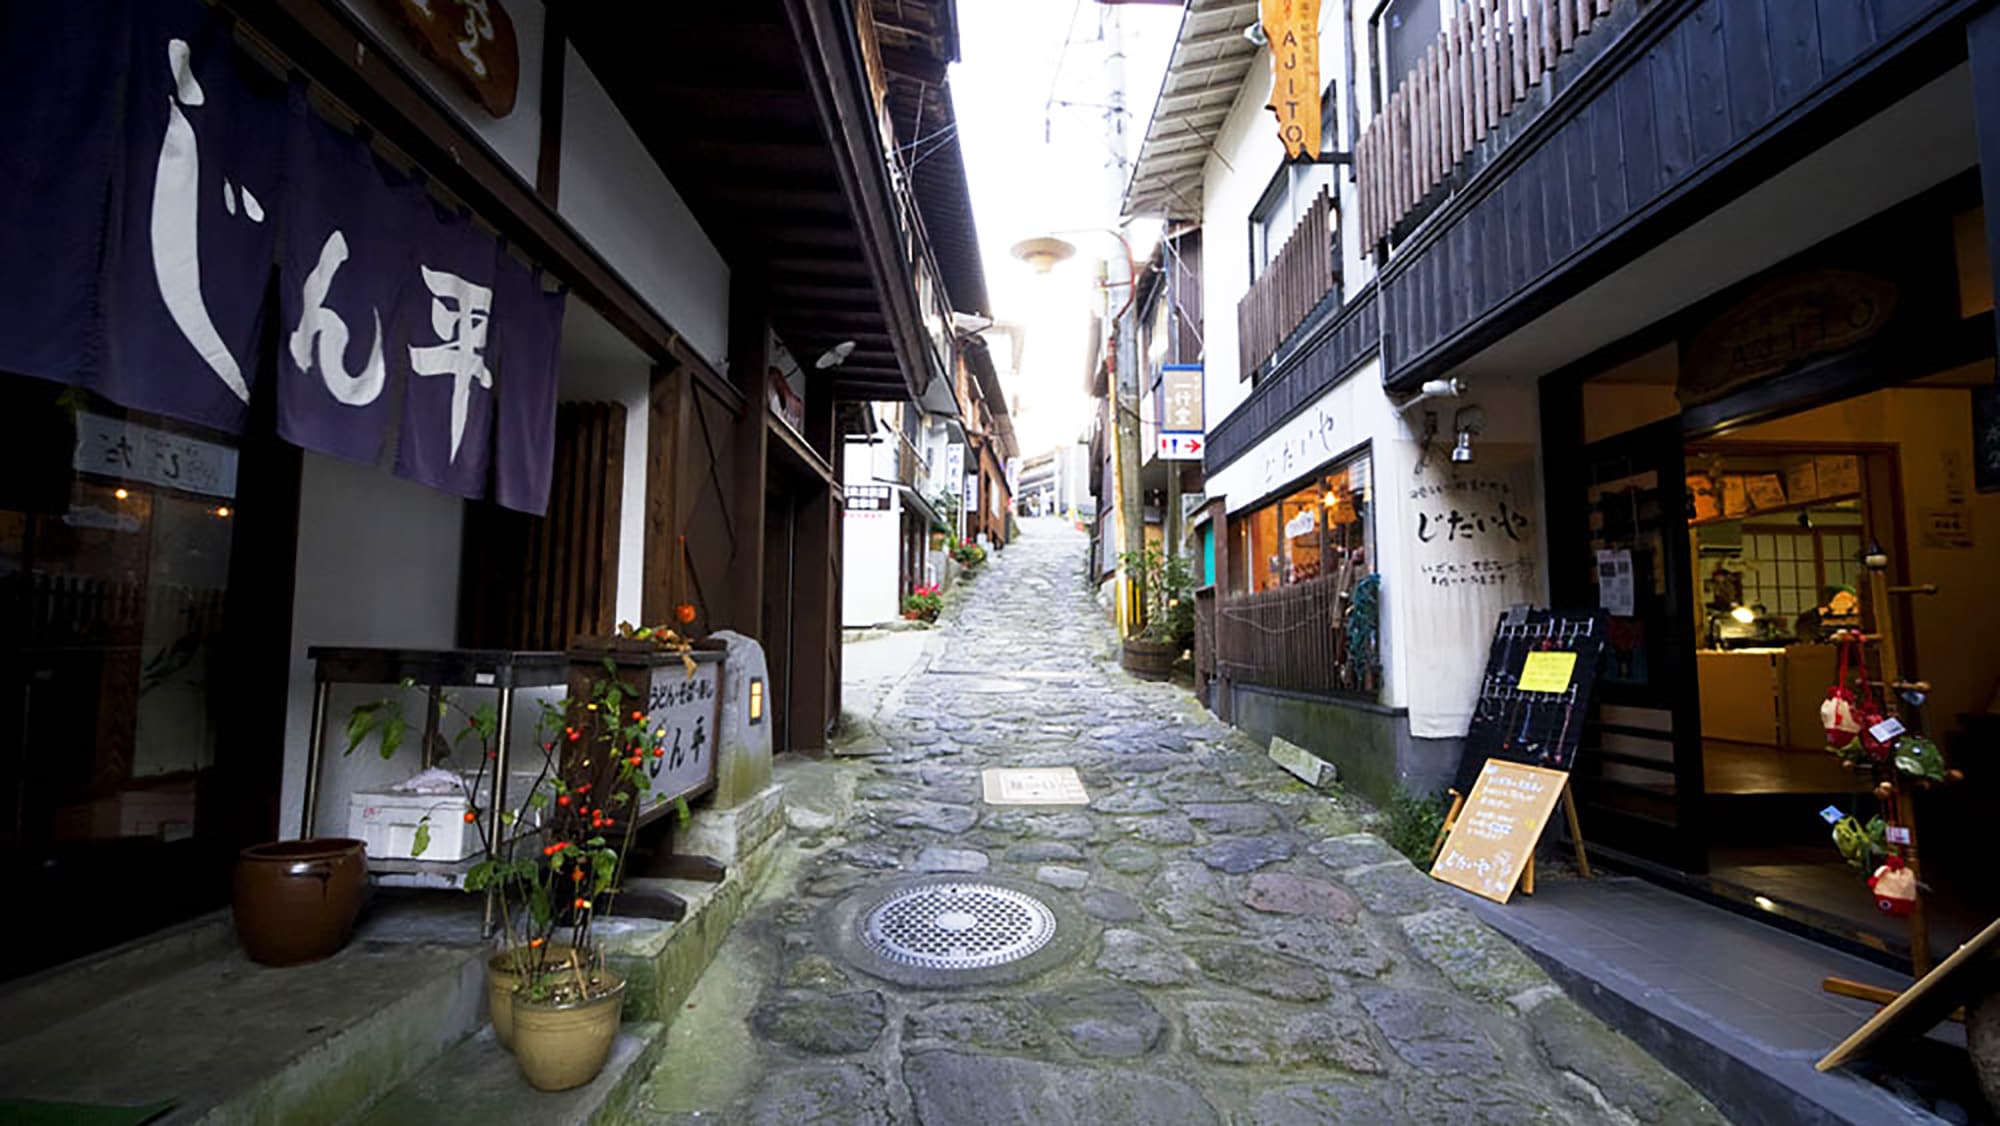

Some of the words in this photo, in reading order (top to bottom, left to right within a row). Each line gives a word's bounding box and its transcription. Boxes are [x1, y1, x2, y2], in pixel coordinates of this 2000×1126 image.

[1282, 30, 1303, 143] AJITO
[151, 38, 493, 465] じん平
[1417, 502, 1528, 543] じだいや
